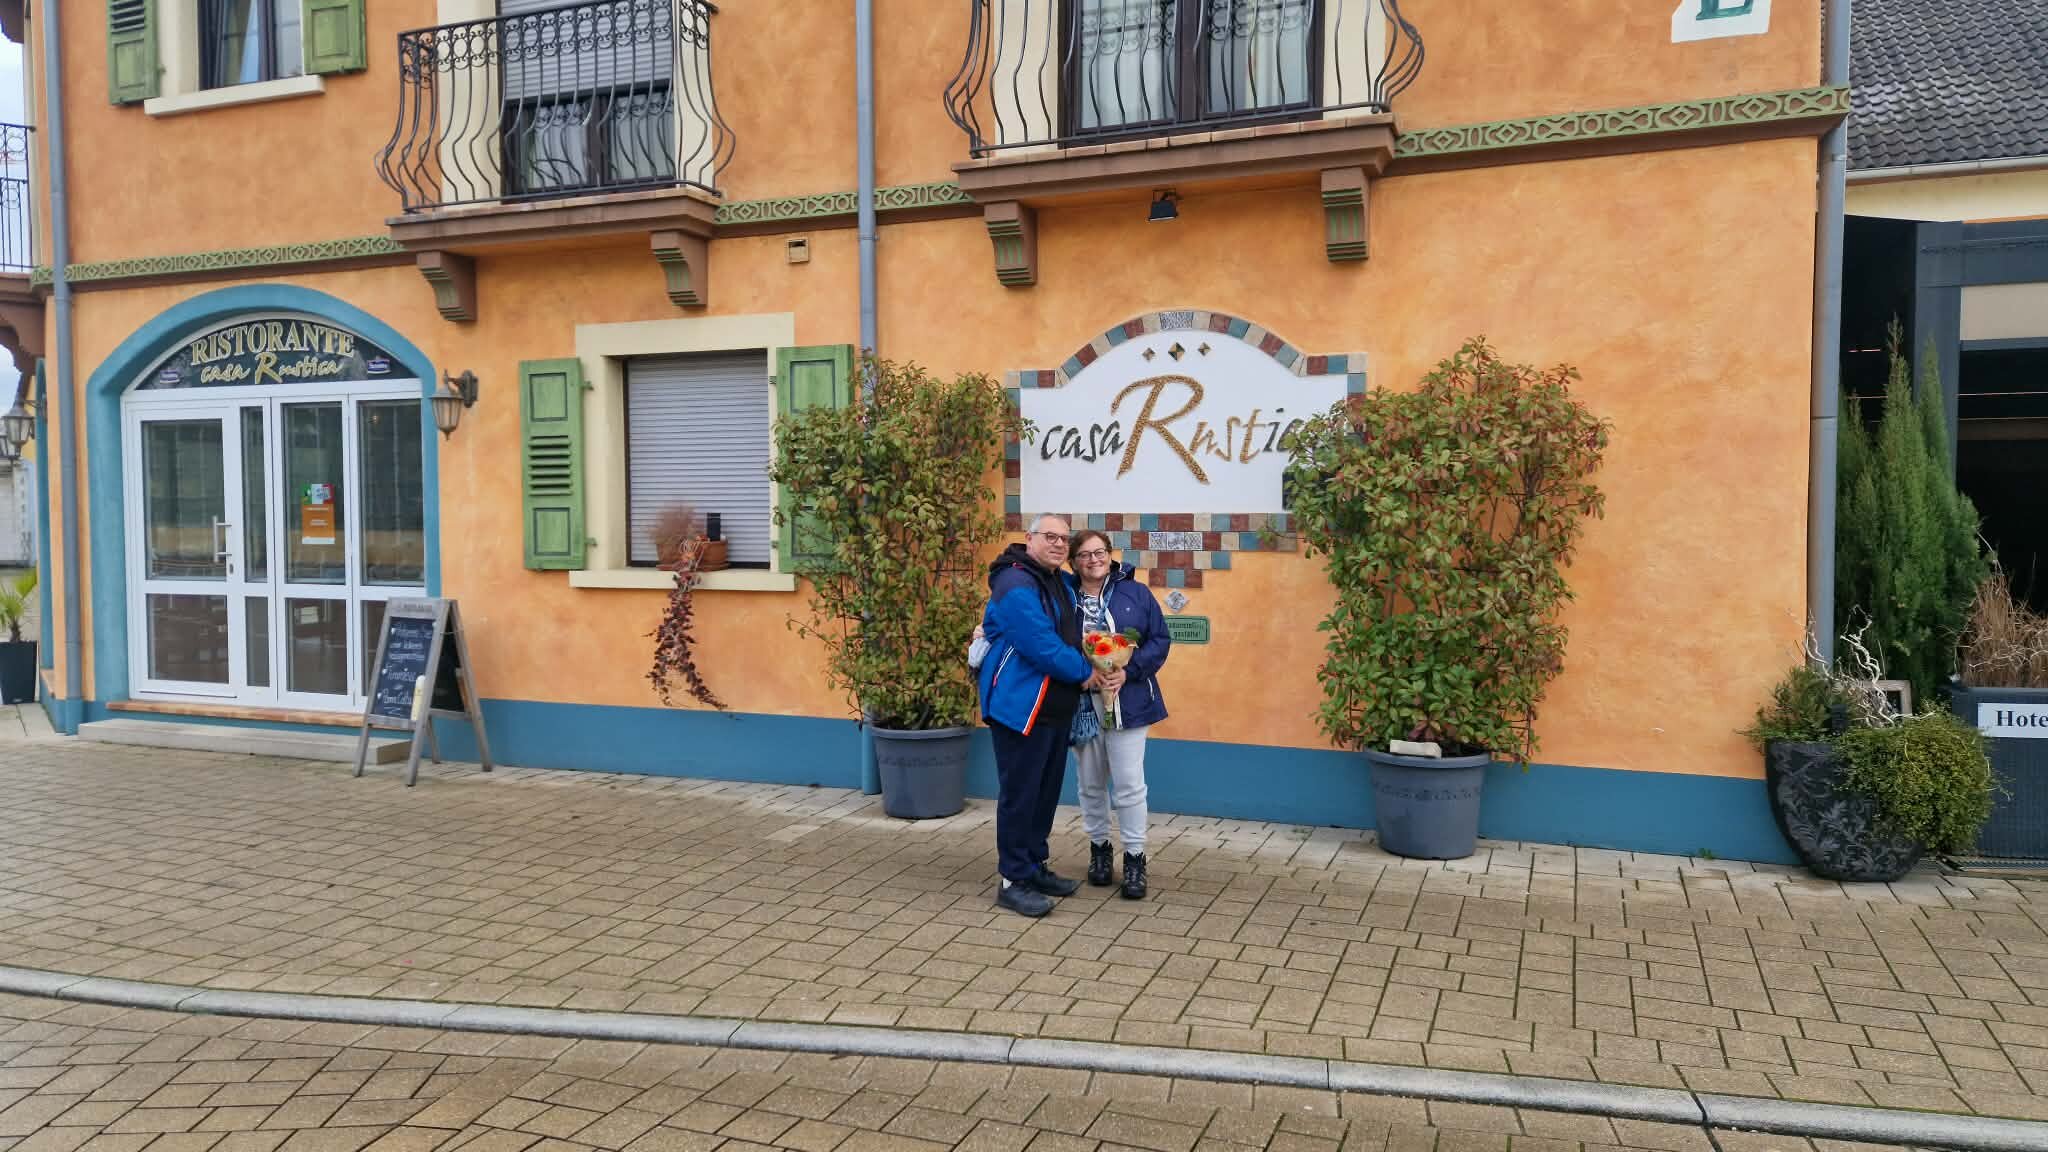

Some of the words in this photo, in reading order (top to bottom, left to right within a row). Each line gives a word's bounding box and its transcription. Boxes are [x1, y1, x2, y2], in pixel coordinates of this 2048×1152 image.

[190, 321, 354, 366] RISTORANTE
[201, 363, 250, 384] casa
[255, 351, 343, 385] Rustica
[1040, 420, 1125, 464] casa
[1110, 374, 1305, 486] Rustic
